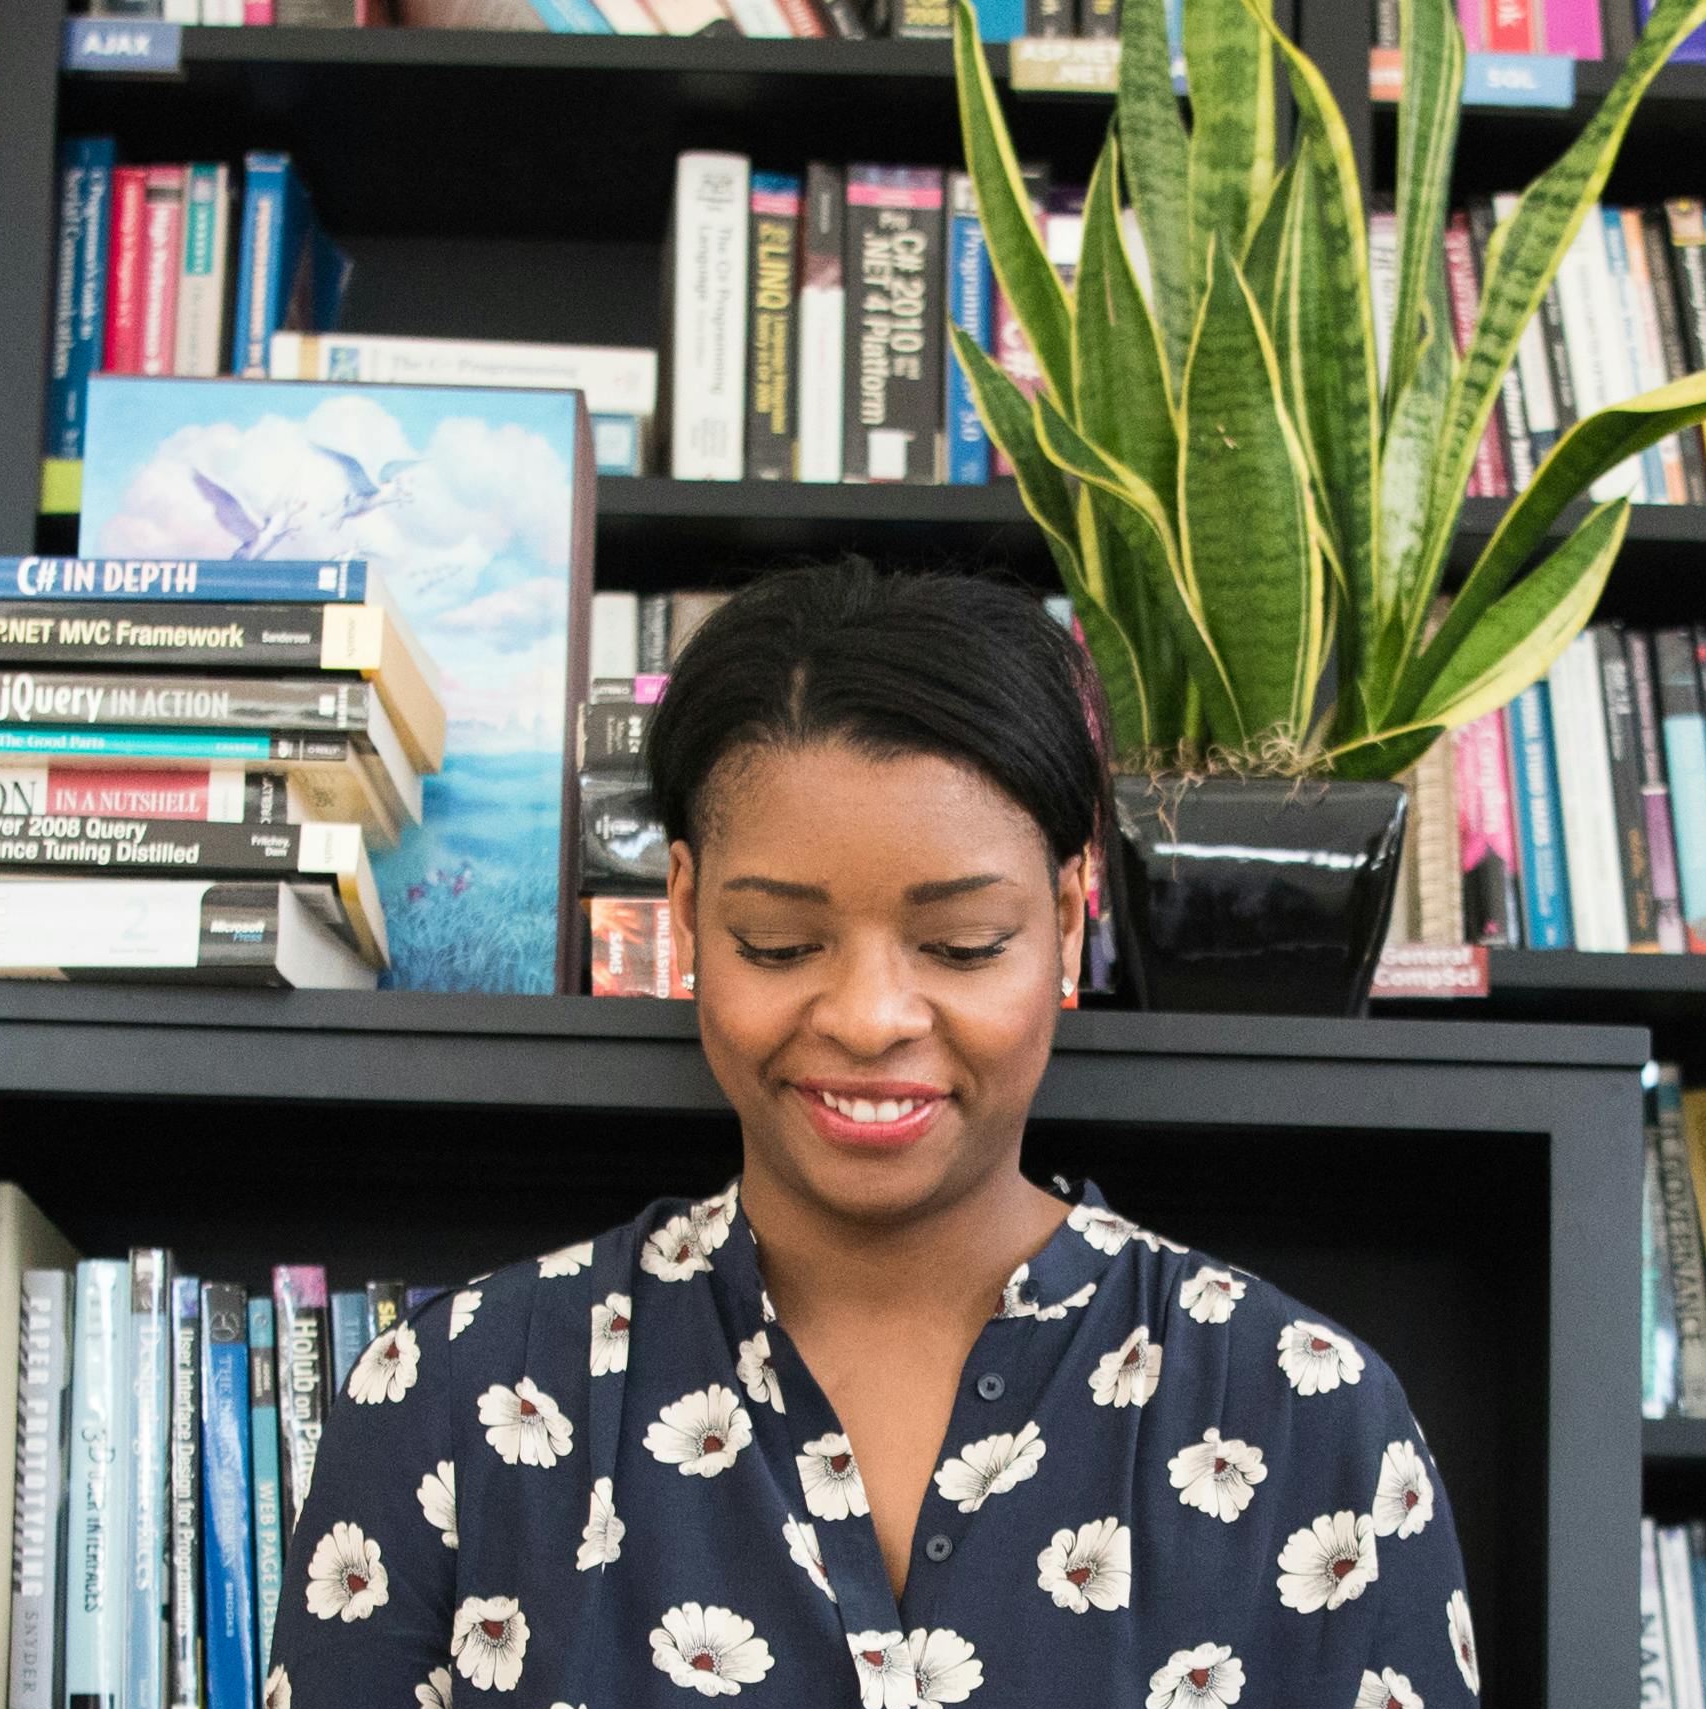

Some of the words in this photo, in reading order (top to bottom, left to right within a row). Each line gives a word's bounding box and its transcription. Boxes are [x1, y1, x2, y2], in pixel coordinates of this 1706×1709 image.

[81, 29, 153, 59] AJAX
[694, 225, 712, 303] Language
[755, 243, 790, 310] LINQ
[862, 232, 892, 291] .NET
[892, 233, 926, 272] C#
[53, 226, 82, 380] Communications
[864, 293, 890, 312] 4
[890, 276, 924, 352] 2010
[709, 288, 733, 396] Programming
[860, 318, 890, 425] Platform
[17, 557, 57, 595] C#
[62, 559, 94, 592] IN
[103, 561, 198, 593] DEPTH
[58, 619, 111, 646] MVC
[115, 618, 244, 649] Framework
[110, 687, 136, 717] IN
[140, 689, 230, 720] ACTION
[26, 733, 65, 749] Good
[68, 734, 106, 750] Parts
[54, 789, 79, 811] IN
[80, 790, 96, 812] A
[100, 789, 201, 814] NUTSHELL
[27, 816, 81, 839] 2008
[85, 817, 148, 846] Query
[42, 838, 112, 867] Tuning
[116, 842, 201, 866] Distilled
[210, 920, 267, 934] Microsoft
[607, 931, 624, 975] SAMS
[656, 907, 671, 999] UNLEASHED
[1383, 945, 1472, 966] General
[1375, 965, 1479, 988] CompSci
[1664, 1156, 1703, 1343] GOVERNANCE
[24, 1296, 53, 1388] PAPER
[175, 1326, 194, 1363] User
[292, 1316, 319, 1393] Holub
[174, 1366, 194, 1438] Interface
[218, 1353, 236, 1394] THE
[218, 1397, 237, 1465] DESIGN
[296, 1395, 311, 1418] on
[80, 1427, 116, 1466] 3D
[174, 1442, 194, 1499] Design
[19, 1398, 50, 1599] PROTOTYPING
[176, 1501, 194, 1528] for
[257, 1479, 278, 1525] WEB
[222, 1498, 238, 1570] DESIGN
[259, 1528, 280, 1585] PAGE
[84, 1515, 104, 1614] INTERFACES
[175, 1529, 194, 1635] Programmers
[223, 1580, 236, 1638] BROOKS
[20, 1610, 40, 1696] SNYDER
